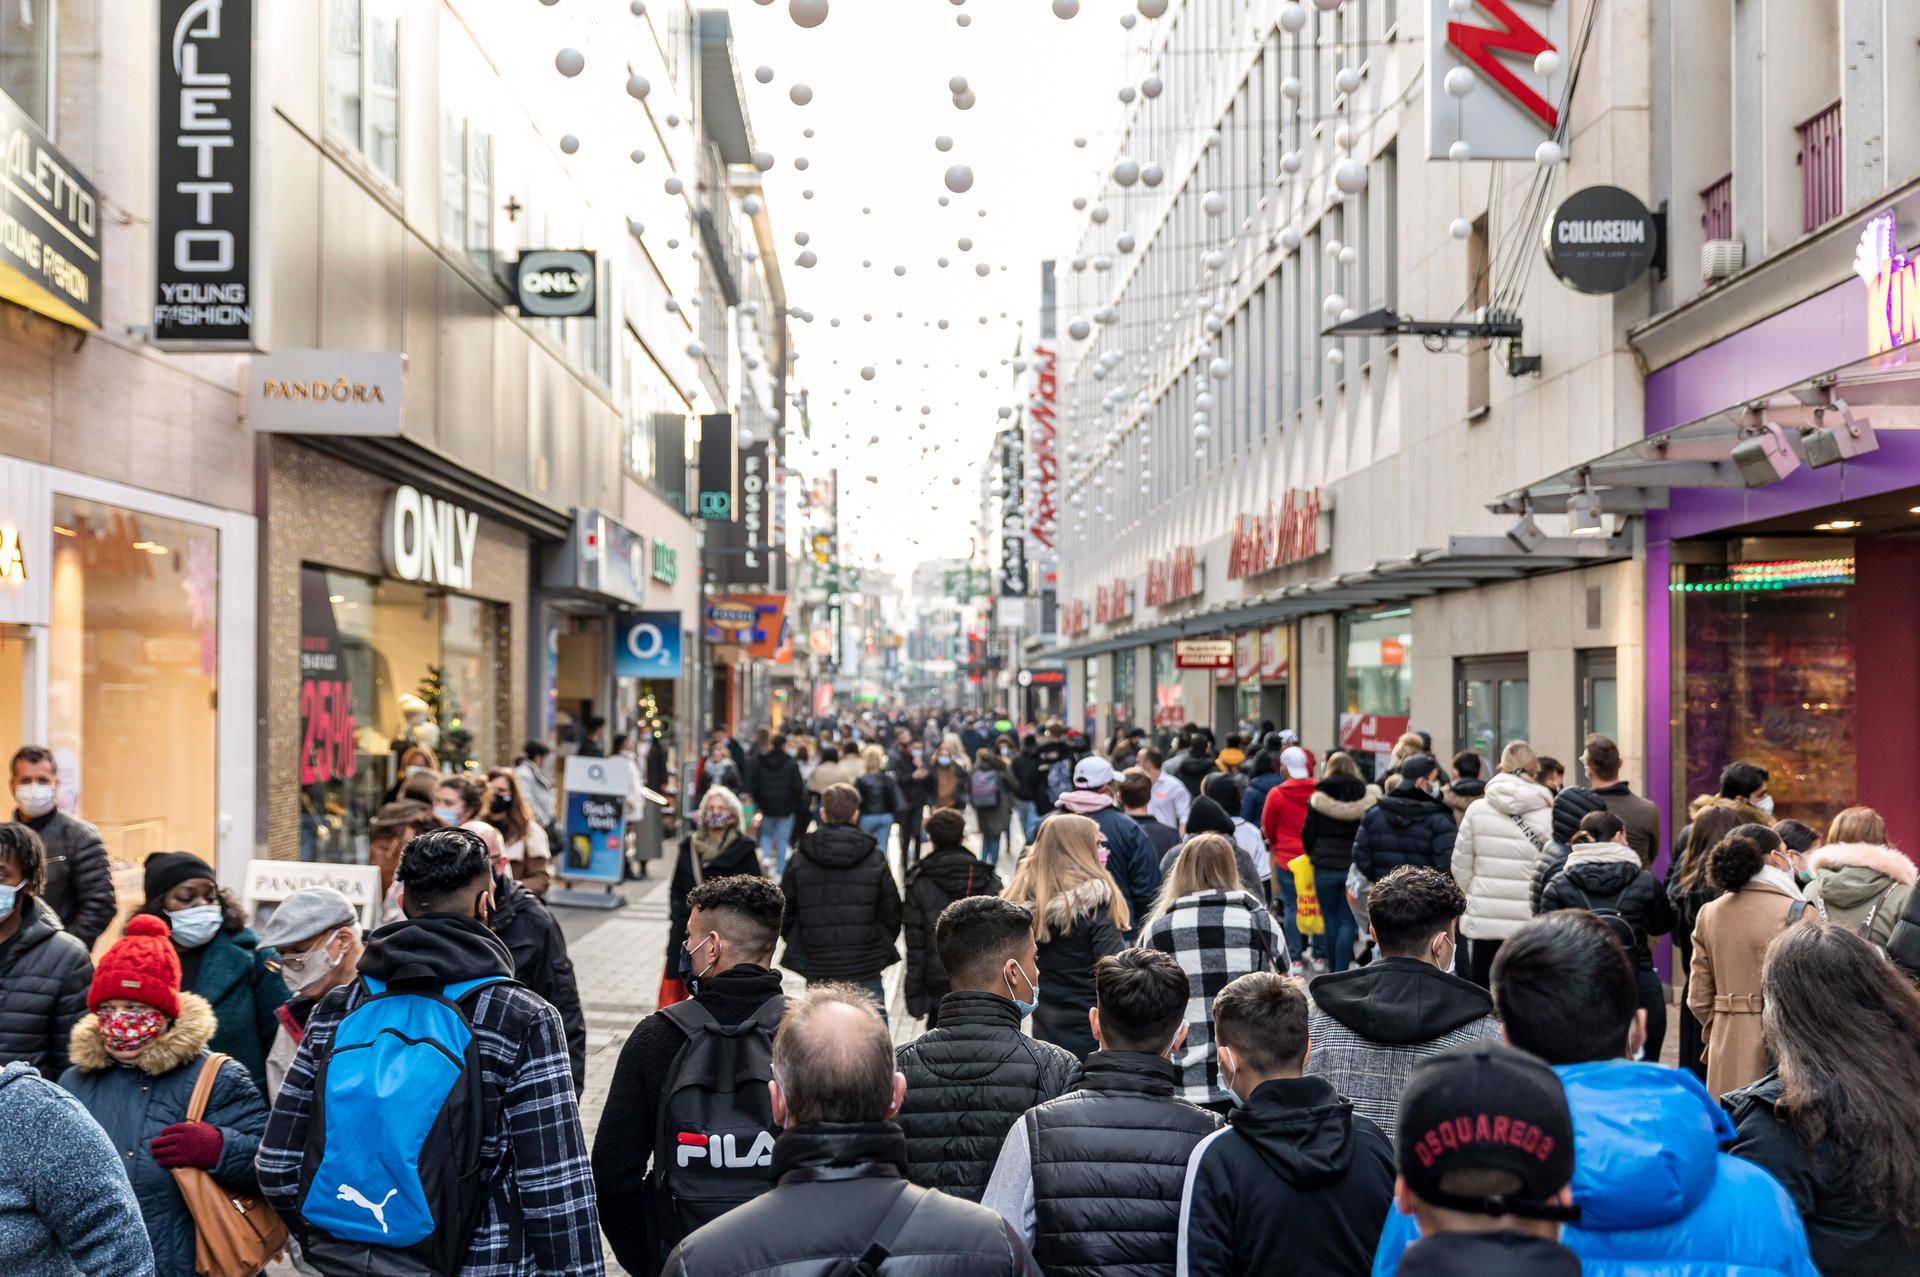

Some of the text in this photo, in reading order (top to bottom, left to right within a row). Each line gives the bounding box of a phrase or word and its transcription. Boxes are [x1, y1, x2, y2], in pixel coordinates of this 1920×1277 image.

[173, 0, 235, 273] ALETTO
[6, 127, 96, 238] ALETTO
[1558, 219, 1646, 244] COLLOSEUM
[161, 283, 246, 304] YOUNG
[522, 271, 591, 293] ONLY
[154, 305, 252, 331] FASHION
[393, 485, 479, 590] ONLY
[744, 456, 763, 568] FOSSIL
[301, 680, 356, 784] 25%
[677, 1131, 776, 1168] FILA
[1414, 1113, 1556, 1168] DSQUARED2
